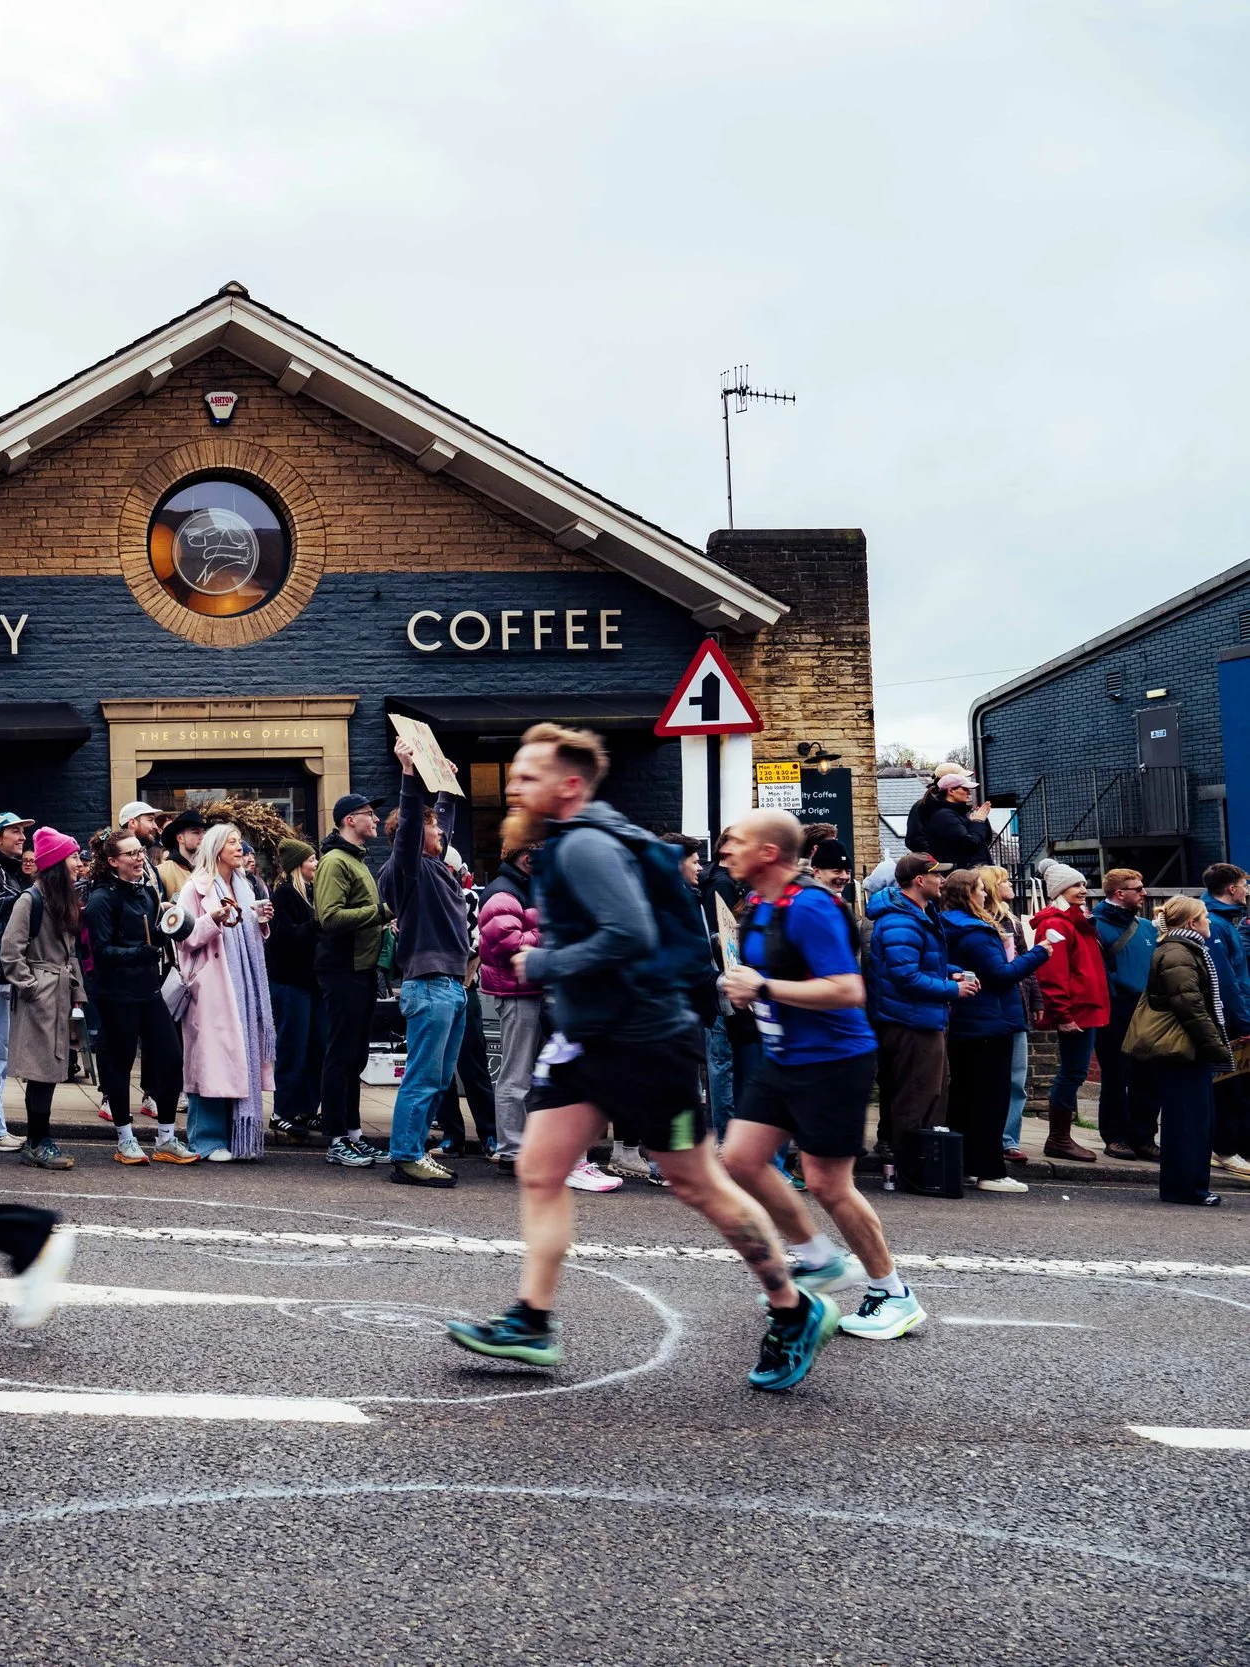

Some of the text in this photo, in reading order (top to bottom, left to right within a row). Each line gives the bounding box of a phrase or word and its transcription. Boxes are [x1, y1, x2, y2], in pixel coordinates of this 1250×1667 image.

[407, 609, 623, 651] COFFEE
[139, 728, 319, 741] THE SORTING OFFICE
[808, 807, 830, 816] Origin
